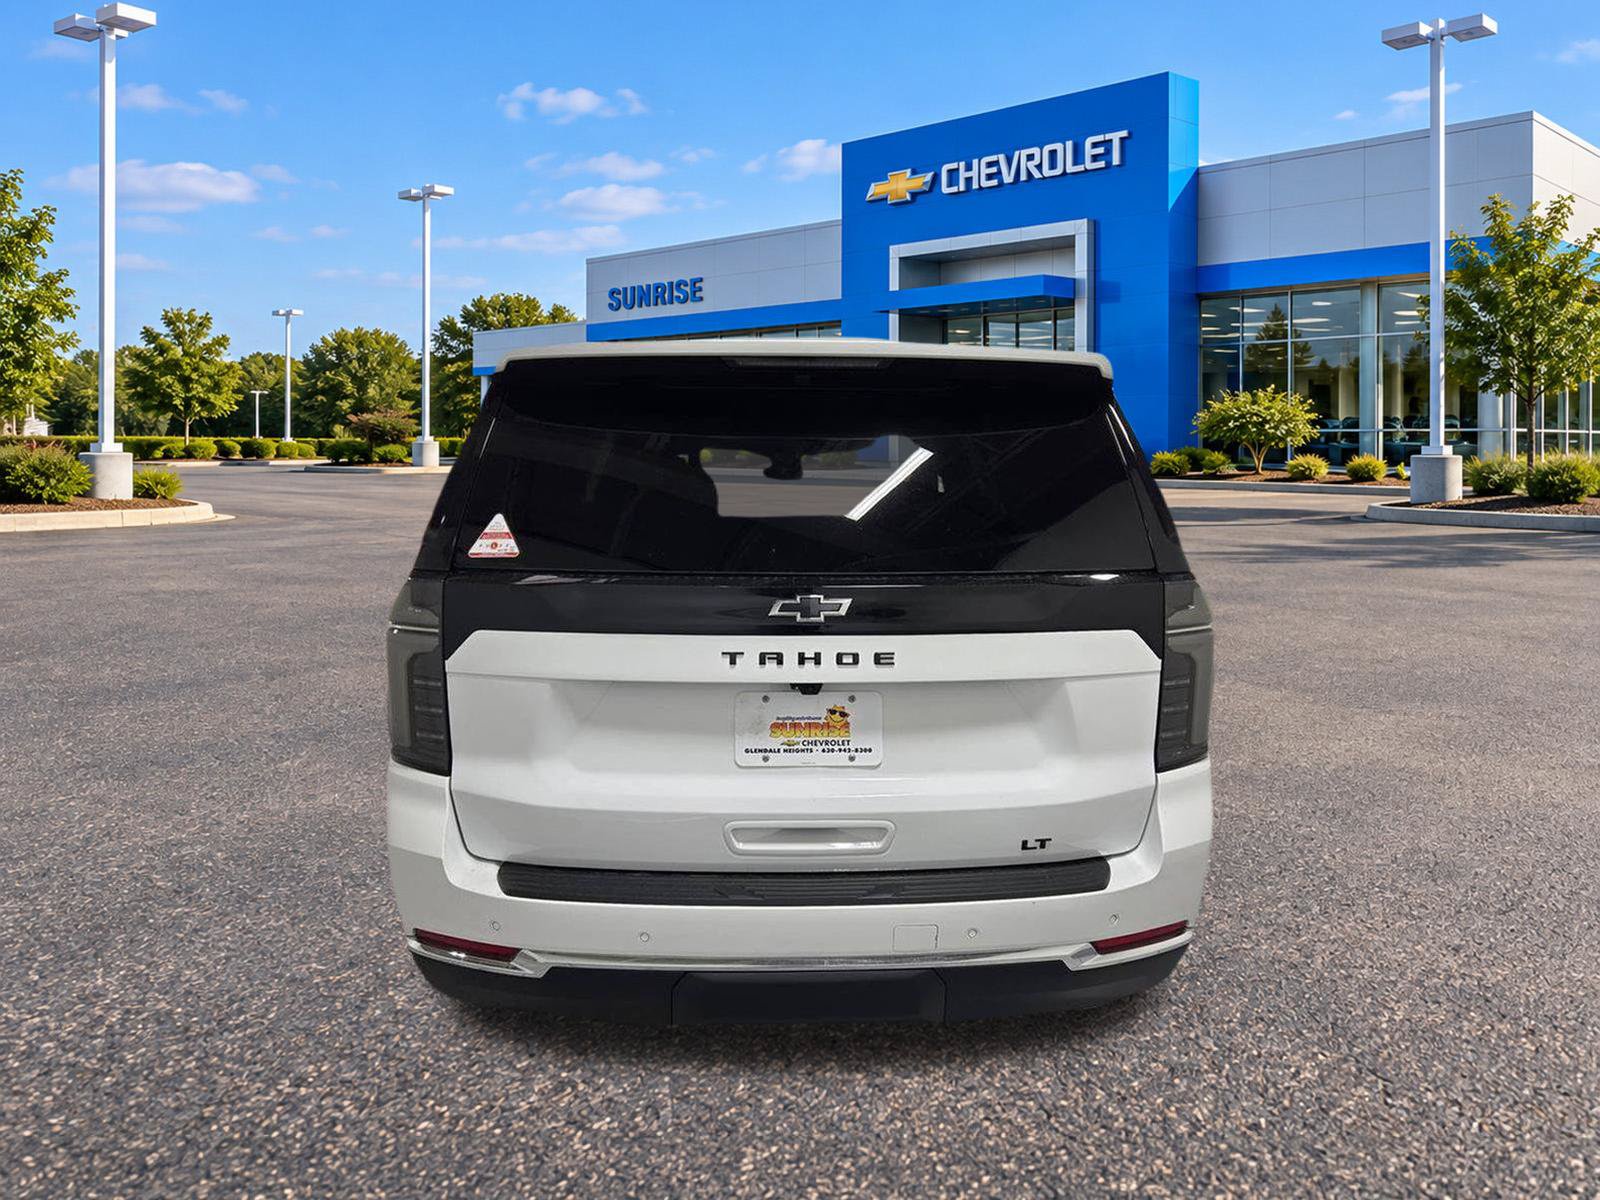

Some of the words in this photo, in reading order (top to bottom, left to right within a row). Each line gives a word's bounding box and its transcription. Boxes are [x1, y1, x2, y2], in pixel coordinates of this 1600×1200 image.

[941, 129, 1129, 194] CHEVROLET
[607, 277, 704, 312] SUNRISE
[721, 651, 895, 666] TAHOE
[769, 721, 851, 738] SUNRISE
[801, 739, 851, 747] CHEVROLET
[1020, 838, 1052, 851] LT
